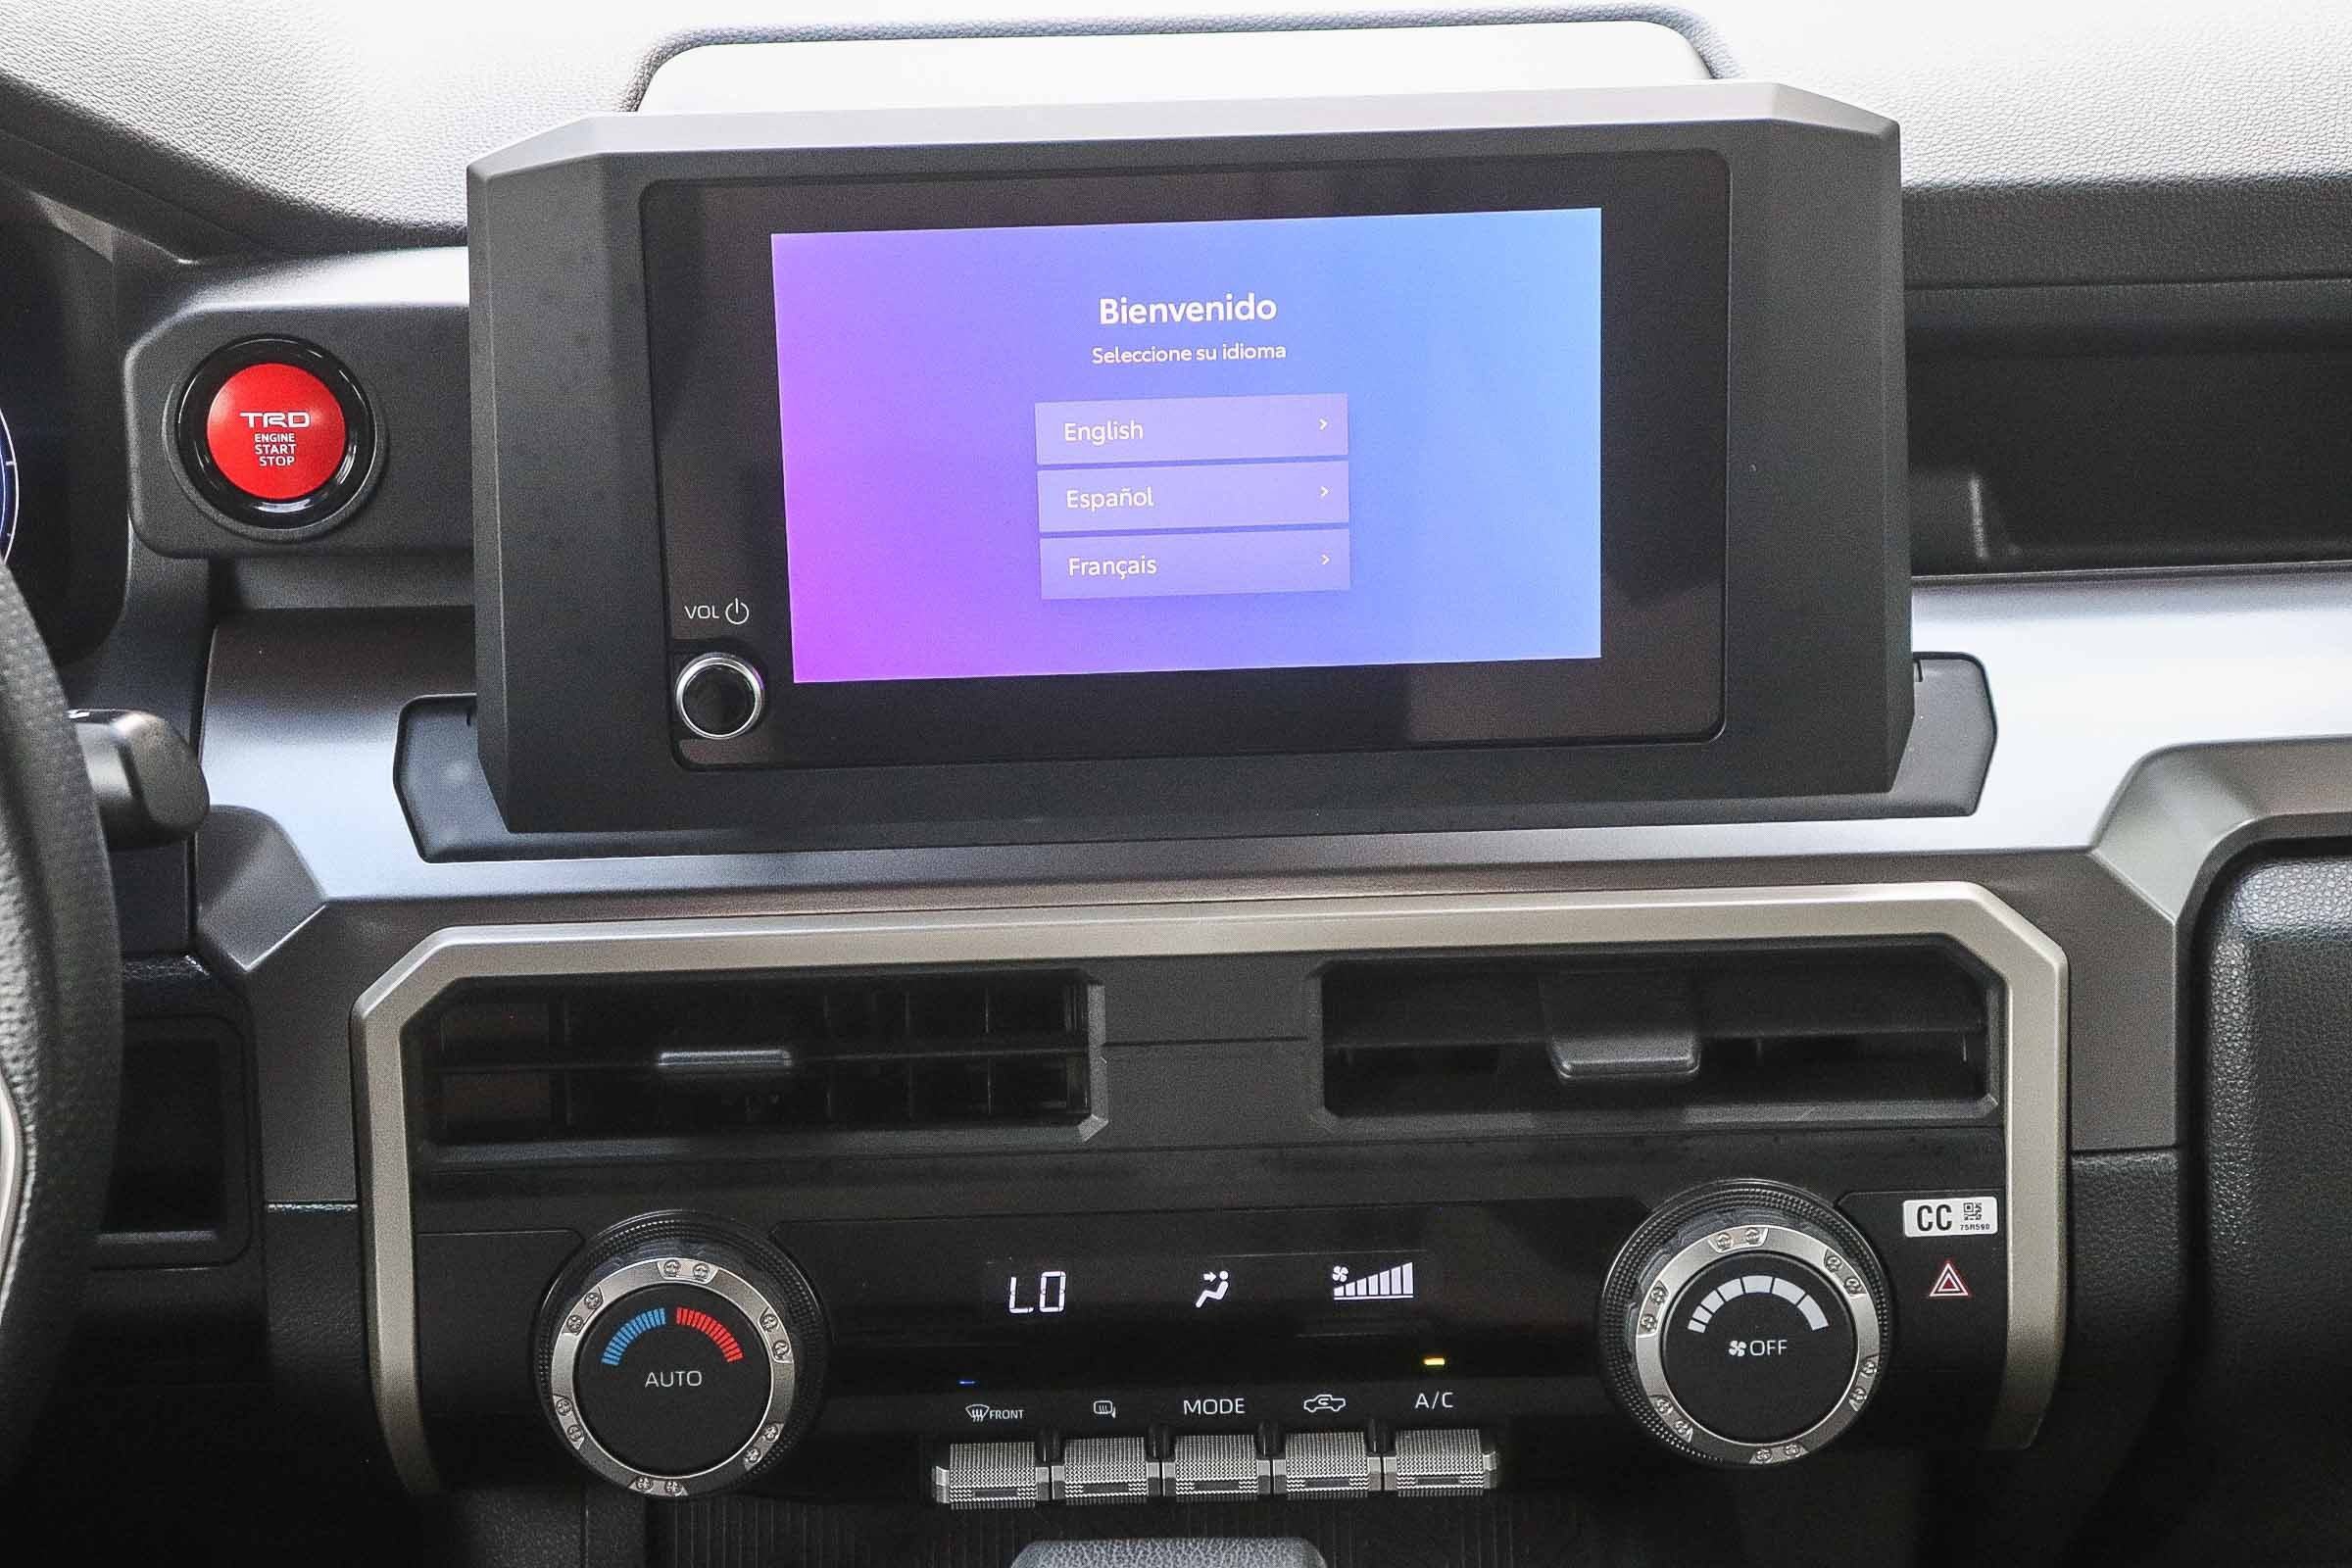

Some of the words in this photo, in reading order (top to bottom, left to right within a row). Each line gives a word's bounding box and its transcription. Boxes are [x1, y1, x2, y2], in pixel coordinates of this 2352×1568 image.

[1099, 291, 1278, 325] Bienvenido
[1091, 343, 1193, 366] Seleccione
[1196, 347, 1218, 362] su
[1221, 342, 1287, 361] idioma
[239, 412, 312, 428] TRD
[254, 432, 296, 443] ENGINE
[1063, 419, 1144, 446] English
[254, 443, 297, 455] START
[259, 455, 295, 466] STOP
[1065, 485, 1154, 513] Español
[1067, 555, 1157, 580] Français
[684, 605, 720, 619] VOL
[1917, 1203, 1953, 1232] CC
[1749, 1339, 1788, 1357] OFF
[644, 1370, 703, 1389] AUTO
[1183, 1397, 1246, 1415] MODE
[1414, 1391, 1454, 1410] A/C
[989, 1409, 1025, 1420] FRONT
